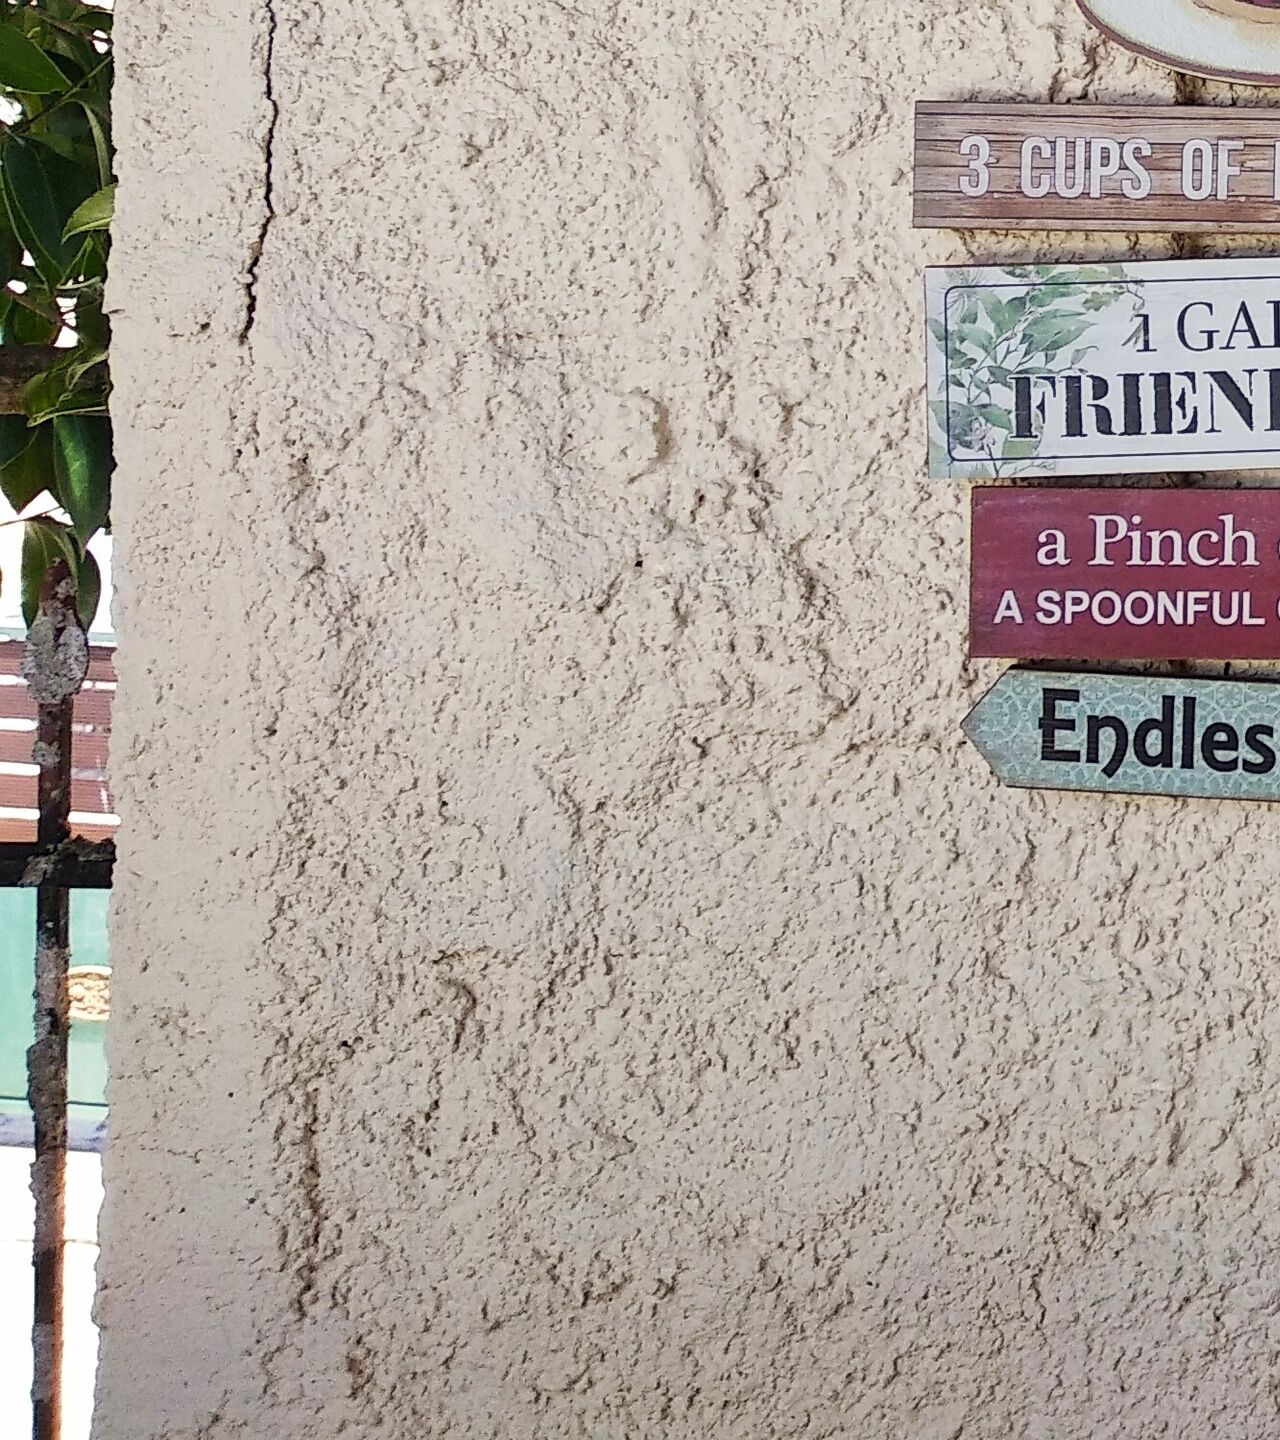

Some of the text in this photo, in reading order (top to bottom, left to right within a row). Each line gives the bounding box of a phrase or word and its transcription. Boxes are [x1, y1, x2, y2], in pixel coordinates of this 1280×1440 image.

[958, 135, 992, 198] 3
[1020, 136, 1153, 200] CUPS
[1181, 138, 1246, 202] OF
[1036, 528, 1070, 567] a
[1087, 513, 1260, 567] Pinch
[993, 593, 1024, 625] A
[1035, 589, 1266, 626] SPOONFUL
